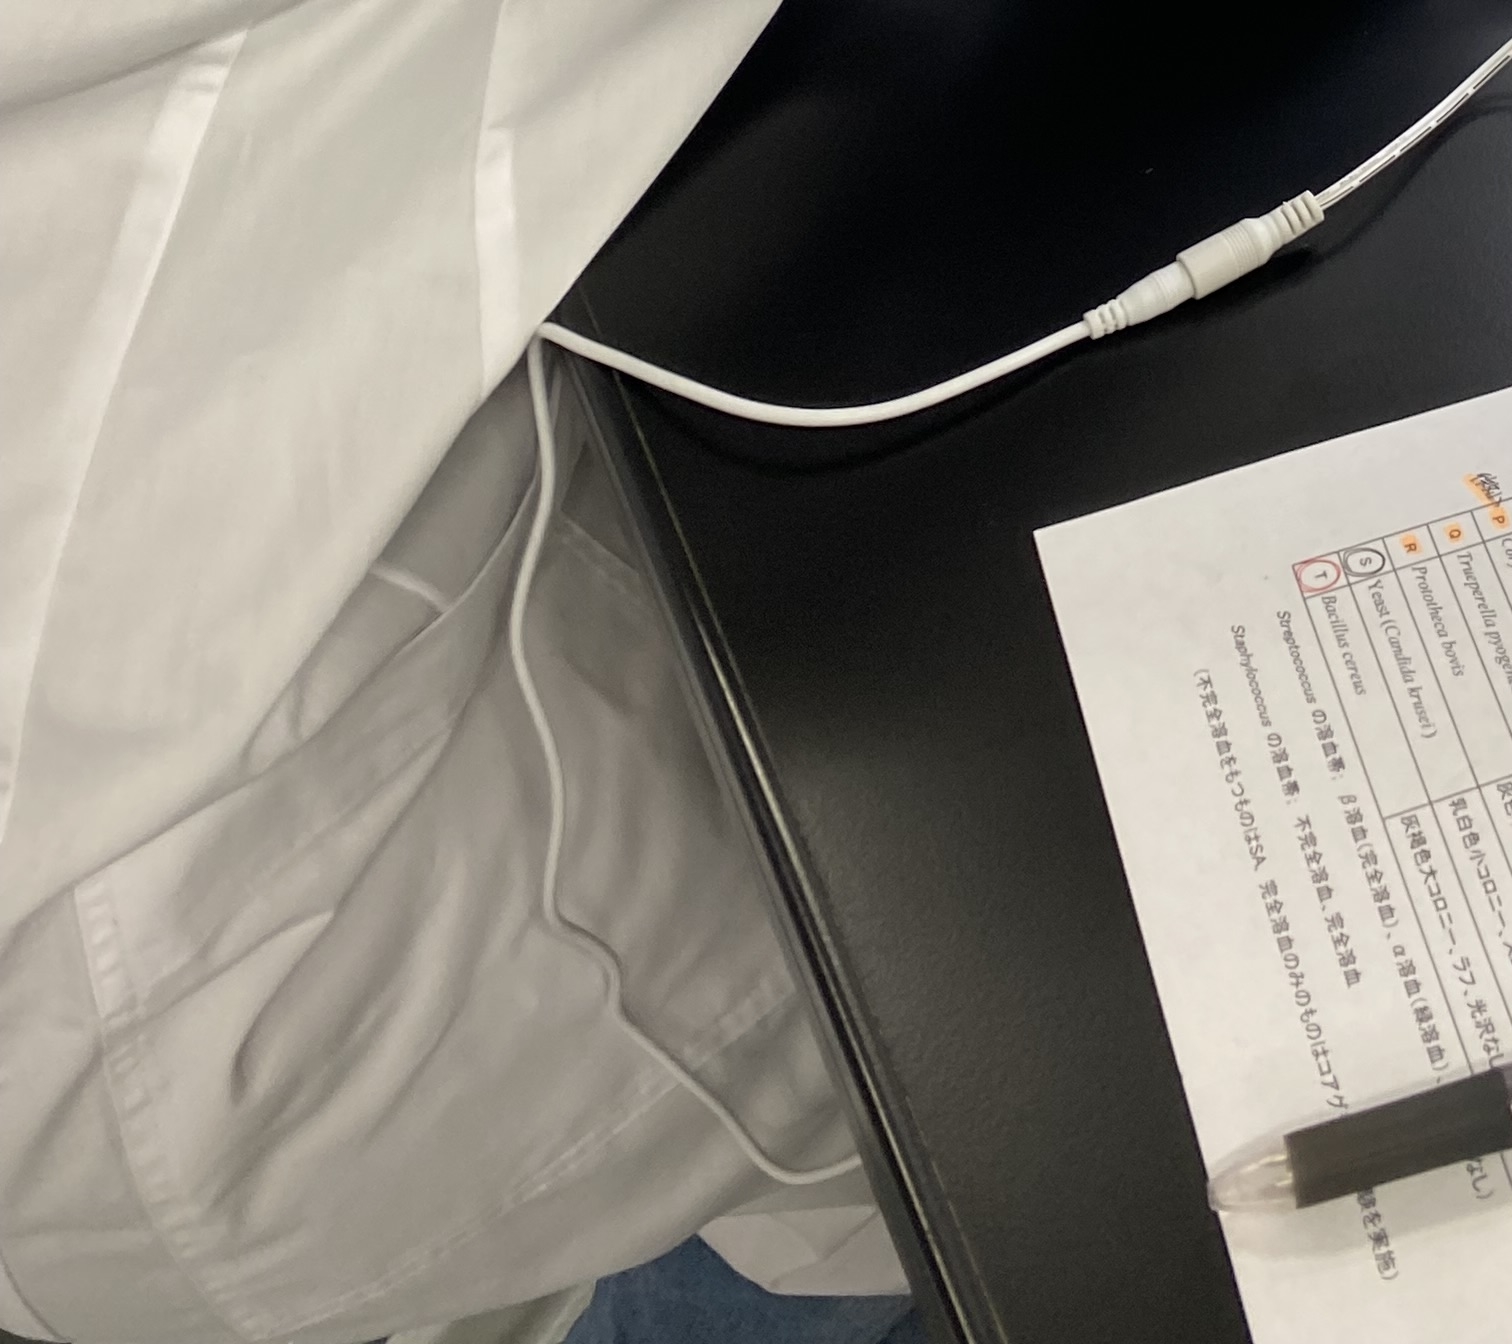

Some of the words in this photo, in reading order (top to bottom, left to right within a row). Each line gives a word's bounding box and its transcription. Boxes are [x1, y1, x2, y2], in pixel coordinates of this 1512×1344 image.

[1365, 579, 1393, 618] Yeast
[1410, 564, 1452, 639] Prototheca
[1440, 638, 1467, 678] bovis
[1454, 551, 1498, 629] Trueperella
[1228, 623, 1275, 729] Staphylococcus
[1274, 608, 1320, 706] Streptococcus
[1320, 593, 1352, 649] Bacillus
[1340, 650, 1367, 696] cereus
[1378, 617, 1418, 684] (Candida
